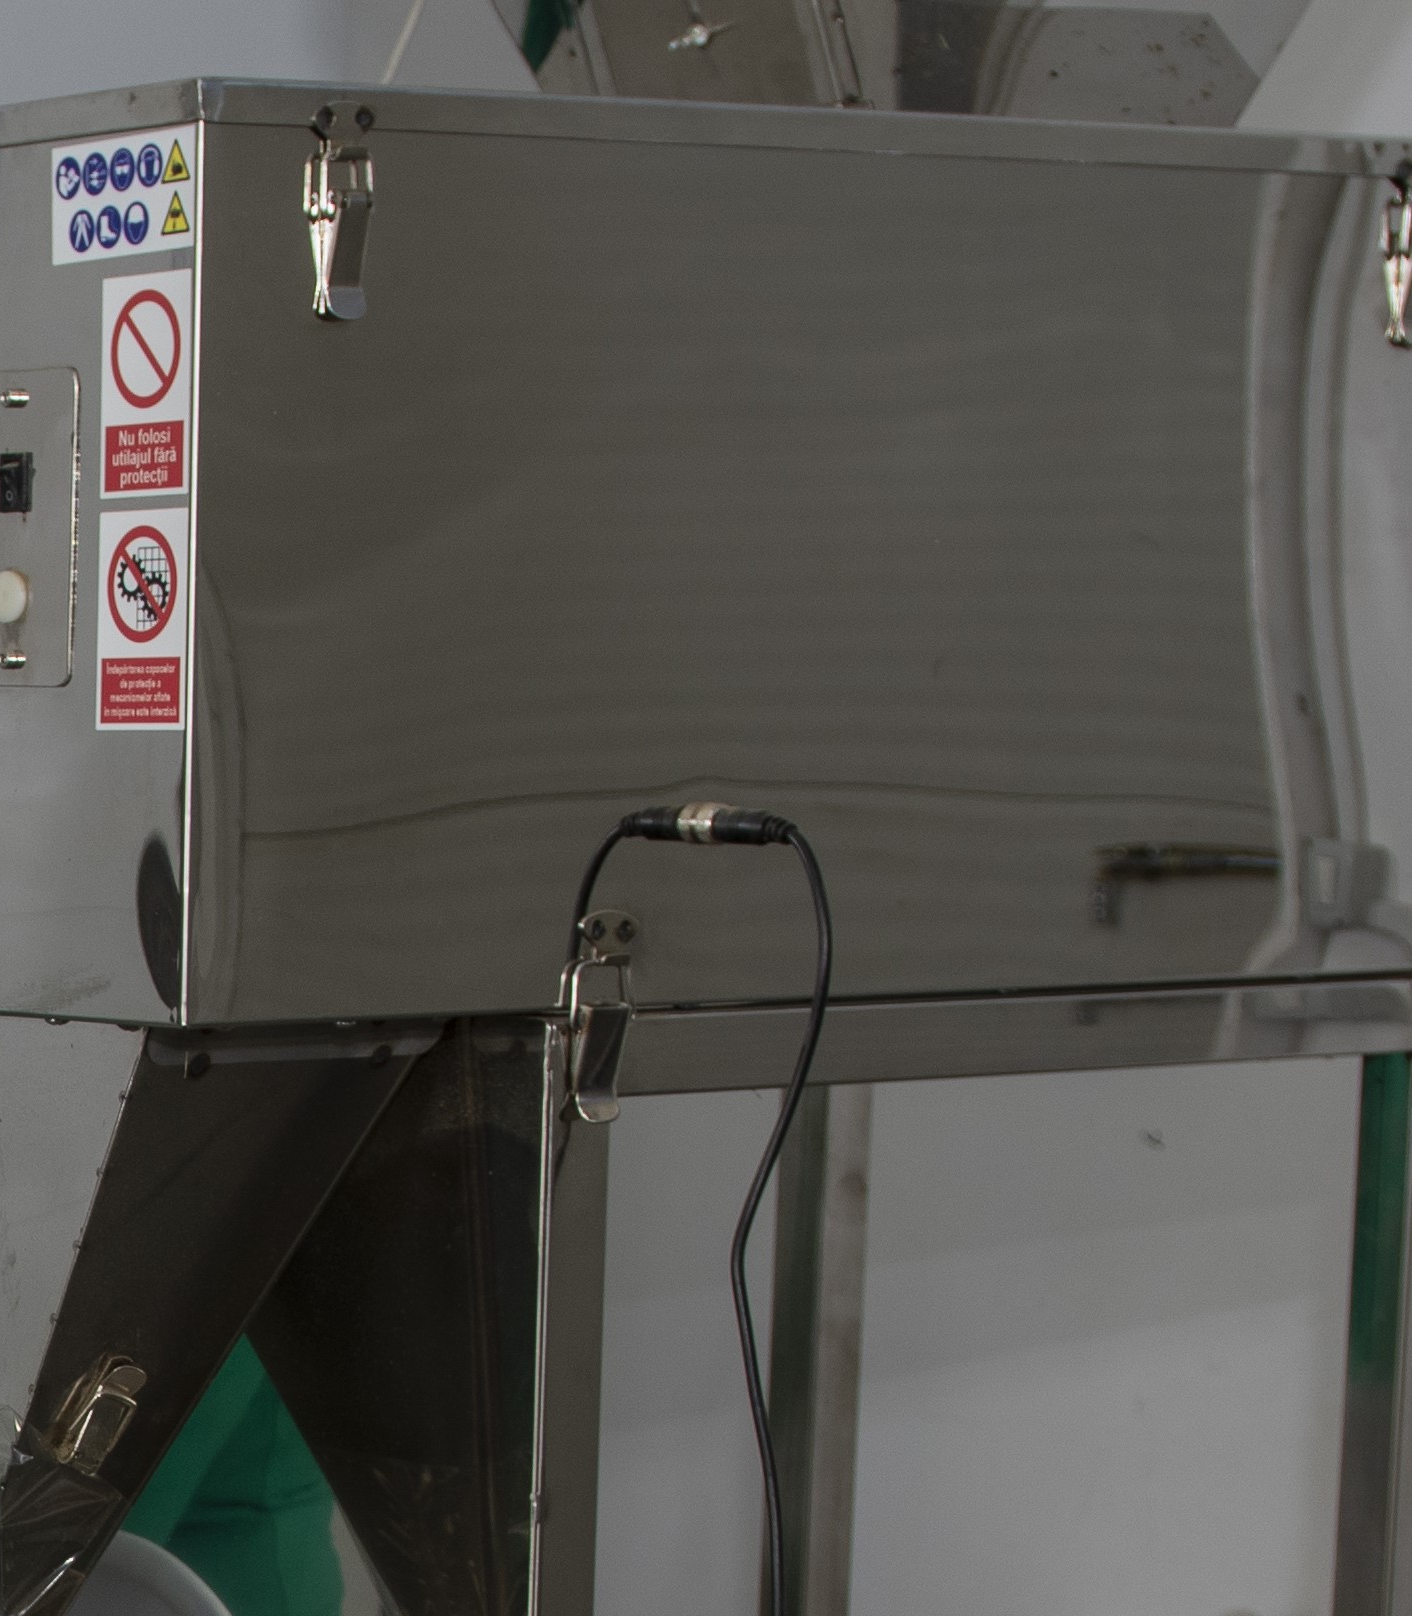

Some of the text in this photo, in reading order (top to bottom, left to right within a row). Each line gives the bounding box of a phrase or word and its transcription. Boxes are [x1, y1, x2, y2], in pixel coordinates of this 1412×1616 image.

[119, 426, 171, 446] Nu folosi
[112, 446, 177, 468] utilajul fără
